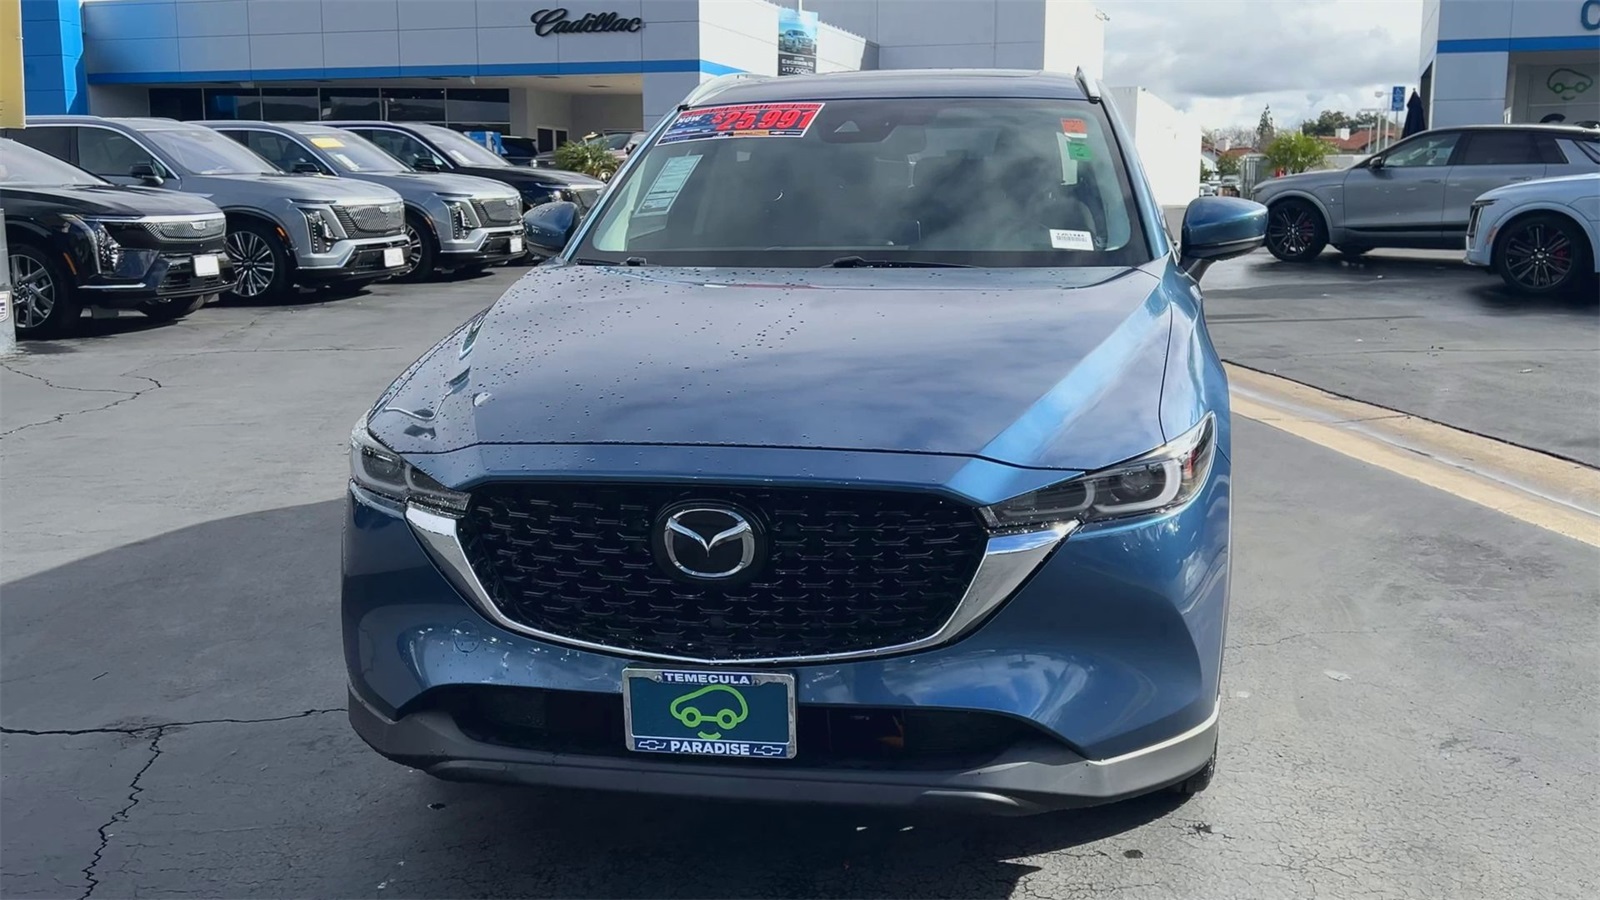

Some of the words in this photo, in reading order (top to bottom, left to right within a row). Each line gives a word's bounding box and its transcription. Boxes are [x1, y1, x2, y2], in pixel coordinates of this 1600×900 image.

[530, 8, 642, 37] Cadillac
[676, 115, 703, 124] NOW
[711, 109, 816, 130] $25,991
[664, 672, 750, 684] TEMECULA
[670, 741, 750, 755] PARADISE
